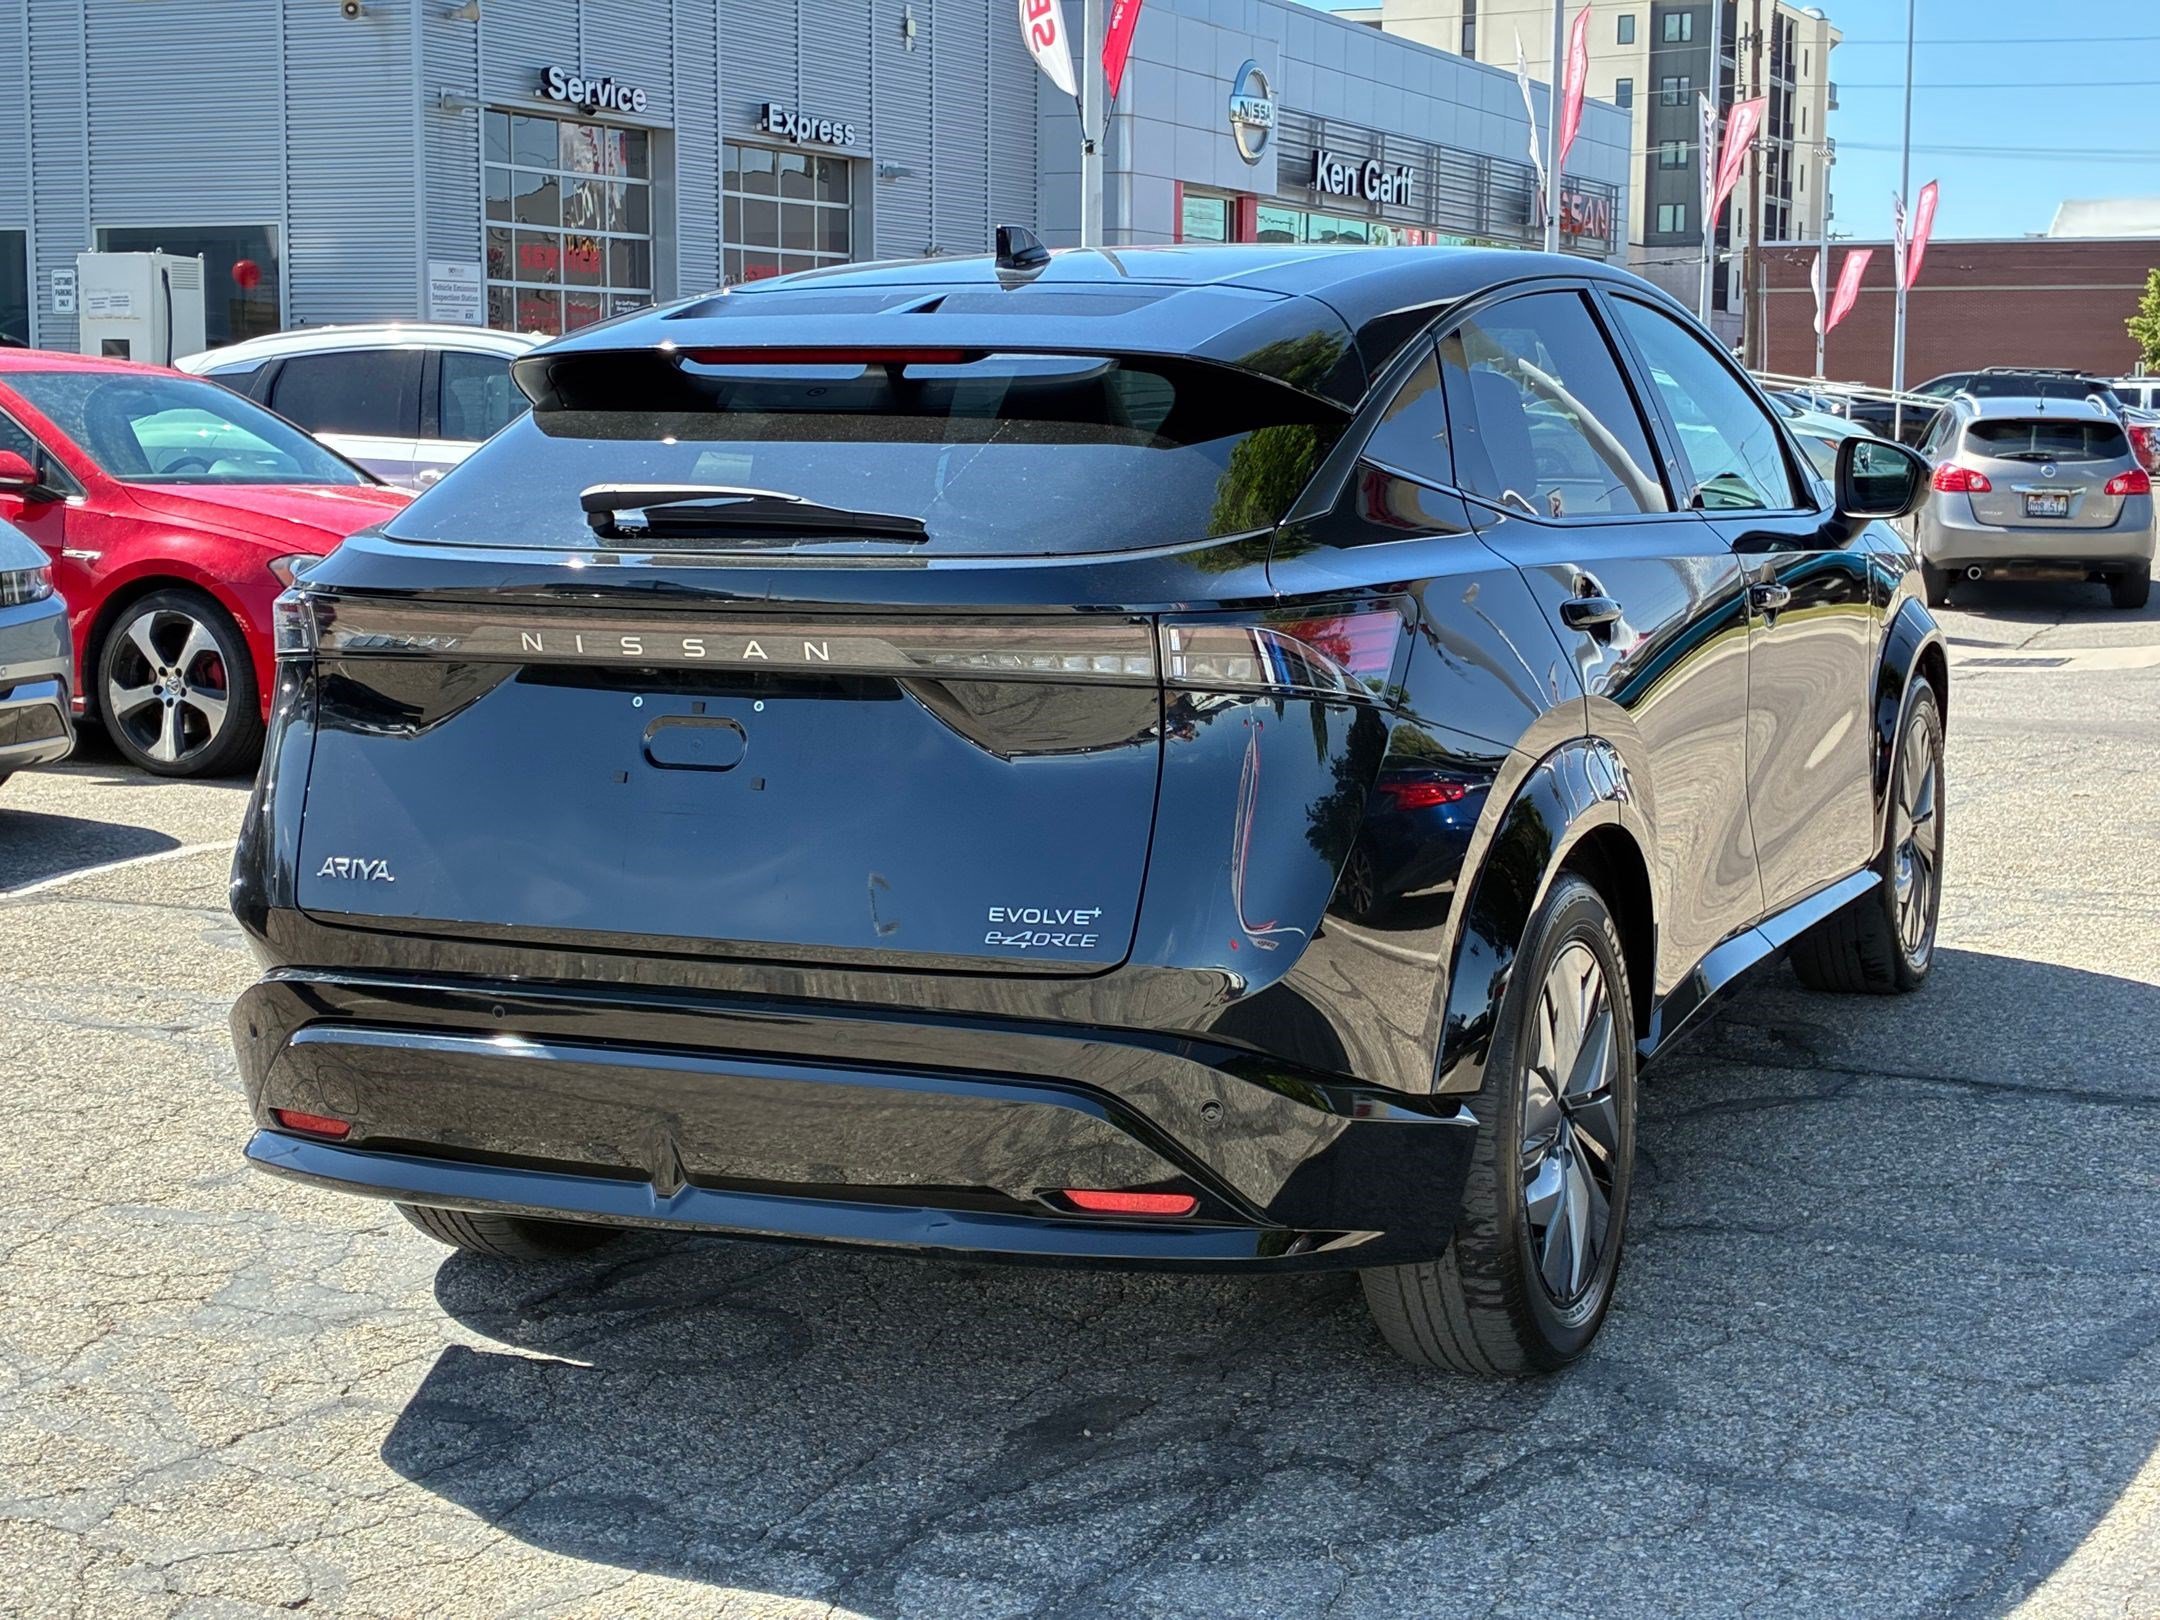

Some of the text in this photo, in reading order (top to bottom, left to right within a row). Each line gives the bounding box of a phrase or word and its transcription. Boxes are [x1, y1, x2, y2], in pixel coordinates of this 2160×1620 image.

[543, 66, 648, 113] Service
[765, 102, 856, 145] Express
[1239, 100, 1272, 121] NISSA
[1315, 150, 1414, 206] Ken Garff
[1535, 186, 1610, 240] NSSAN
[521, 631, 830, 662] NISSAN
[316, 856, 395, 882] ARIYA
[988, 906, 1102, 925] EVOLVE+
